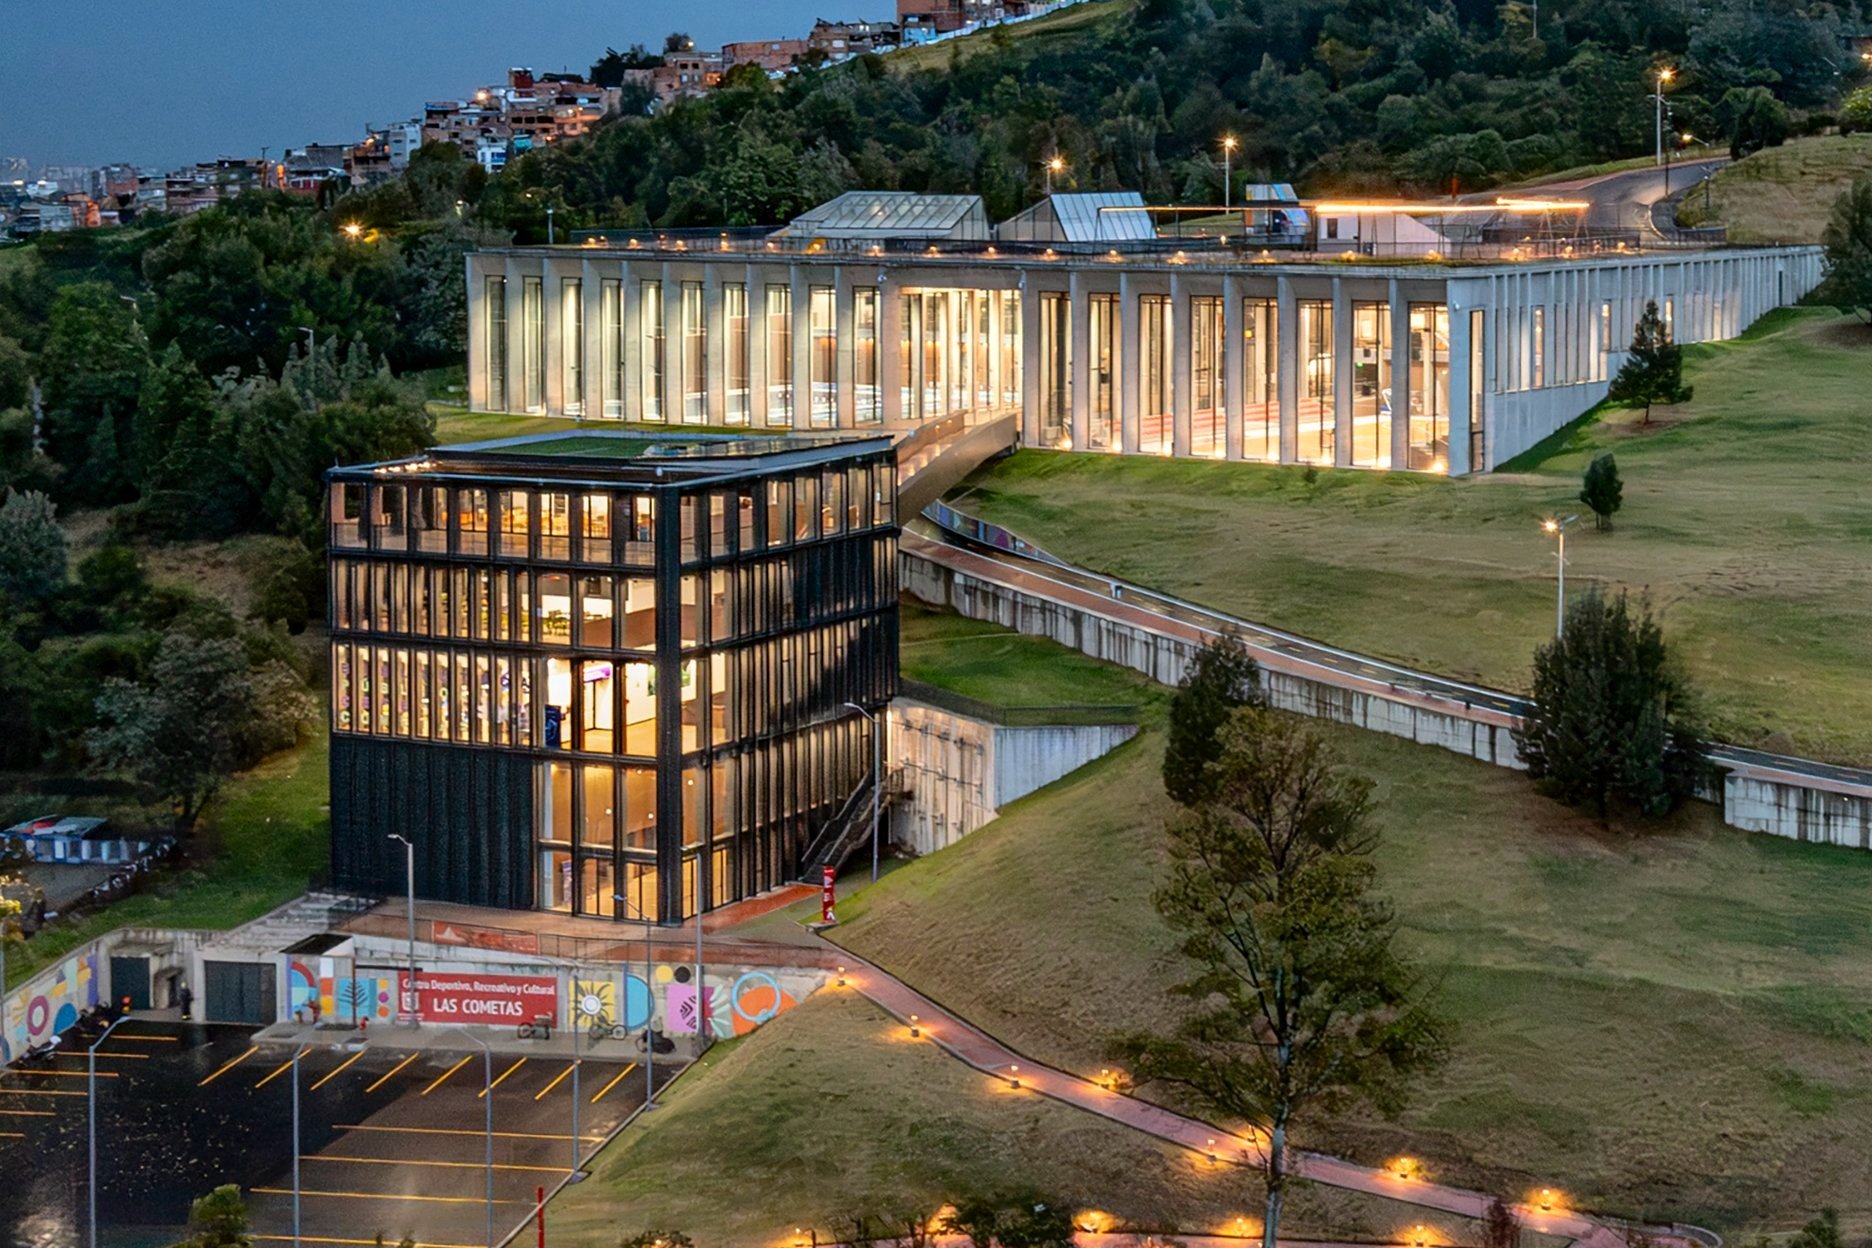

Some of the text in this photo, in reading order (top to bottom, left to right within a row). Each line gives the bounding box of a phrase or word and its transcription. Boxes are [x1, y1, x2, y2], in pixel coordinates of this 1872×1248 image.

[431, 979, 472, 991] Deportivo,
[473, 981, 515, 993] Recreativo
[516, 985, 521, 995] y
[522, 984, 555, 995] Cultural
[433, 998, 523, 1015] LAS COMETAS
